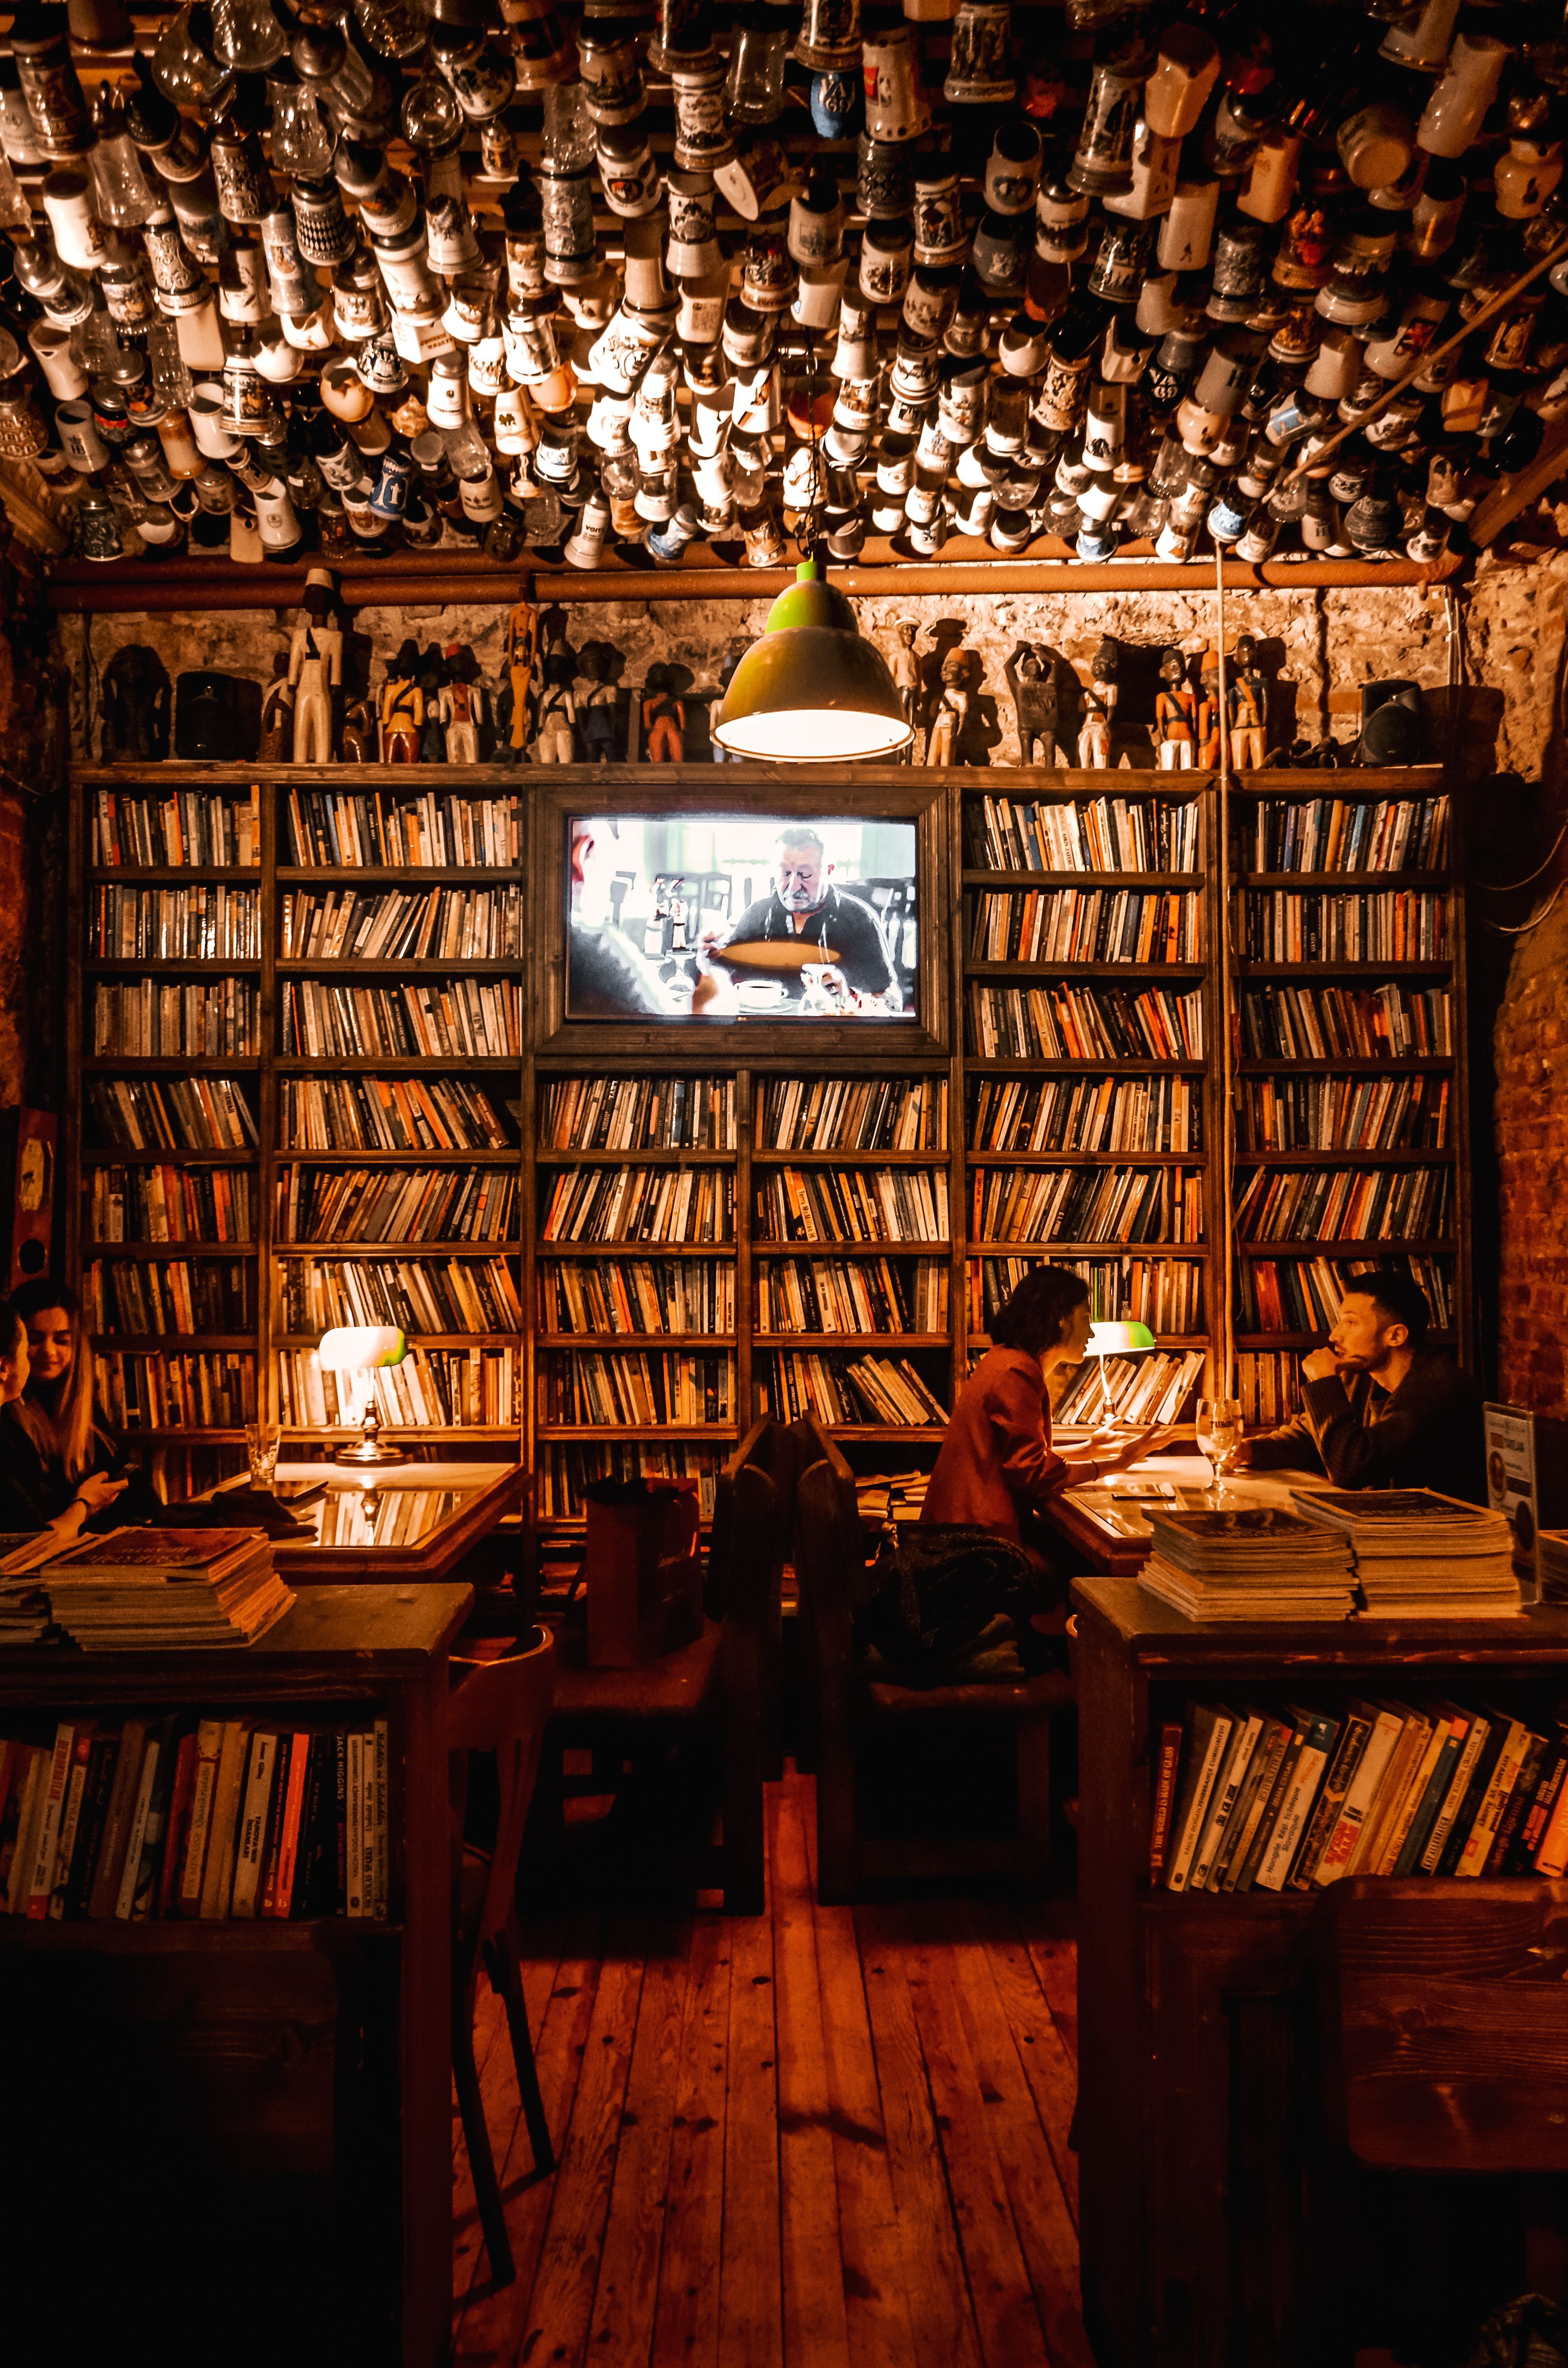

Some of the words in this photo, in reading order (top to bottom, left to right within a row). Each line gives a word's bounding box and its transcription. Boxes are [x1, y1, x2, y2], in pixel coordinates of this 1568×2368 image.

[797, 1189, 808, 1205] Terry
[800, 1204, 815, 1232] McMillan
[336, 1735, 345, 1758] JACK
[1162, 1745, 1175, 1769] GLASS
[336, 1760, 345, 1800] HIGGINS
[1161, 1767, 1172, 1779] OF
[1487, 1788, 1498, 1799] VE
[1534, 1779, 1550, 1802] DAVID
[1155, 1806, 1167, 1834] WORLD
[1189, 1806, 1203, 1833] DOĞAN
[1281, 1812, 1302, 1853] Slovaquie
